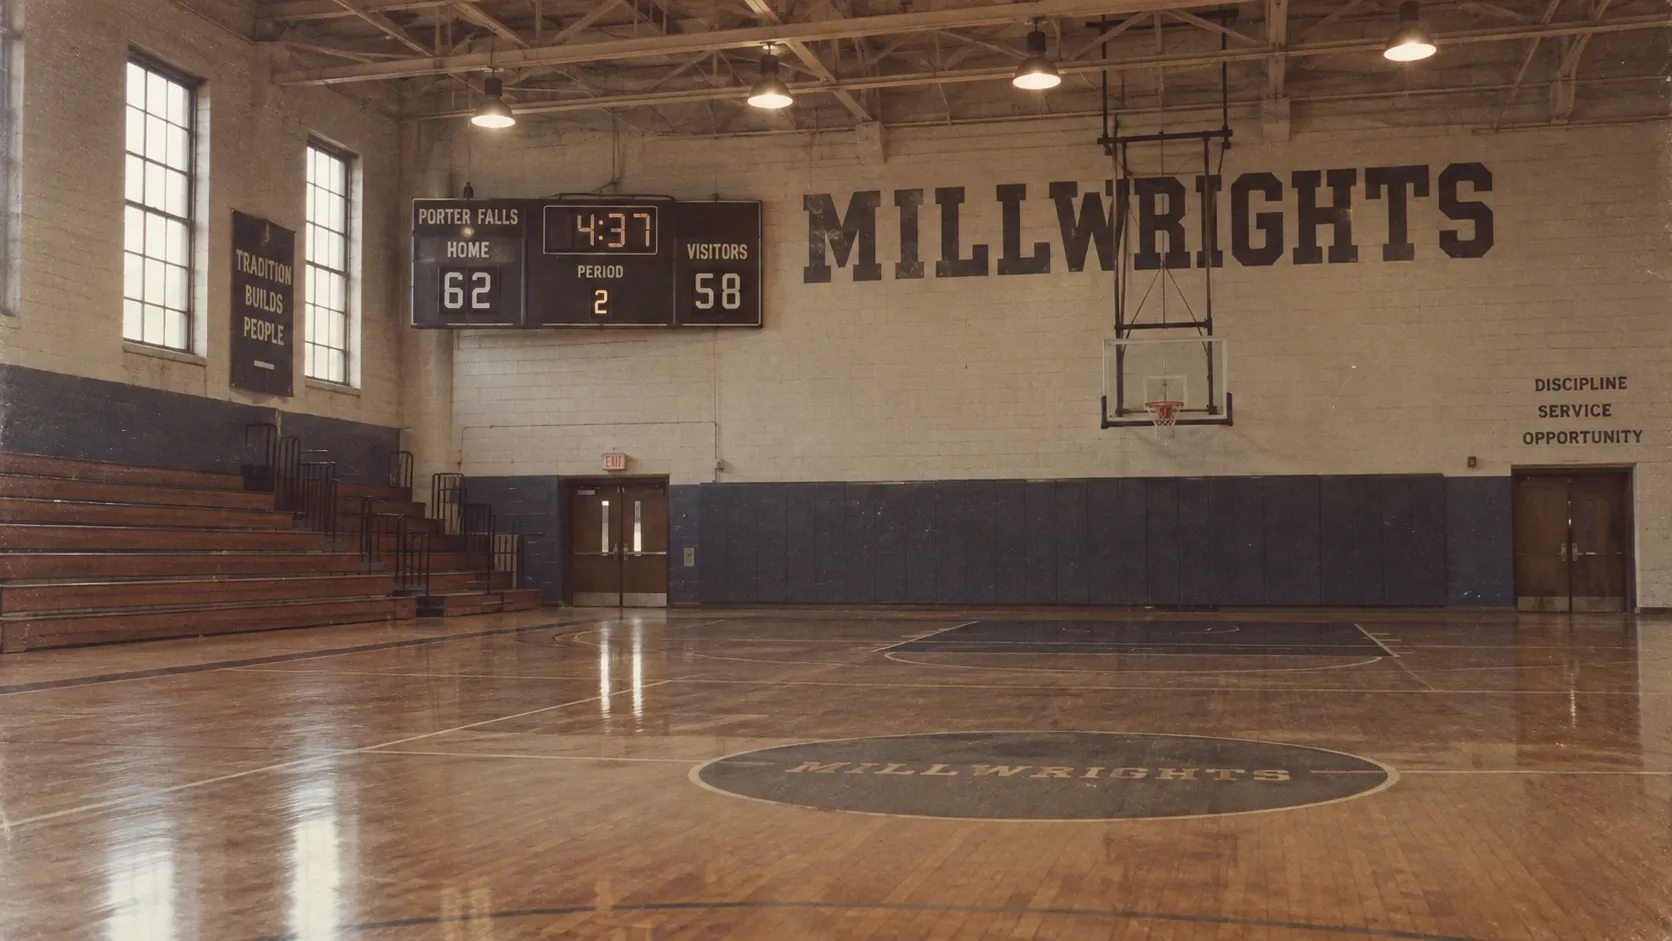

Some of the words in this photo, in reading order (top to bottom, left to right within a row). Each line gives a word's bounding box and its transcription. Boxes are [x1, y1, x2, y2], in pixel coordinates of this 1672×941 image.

[418, 208, 471, 226] PORTER
[478, 208, 519, 226] FALLS
[803, 162, 1494, 284] MILLWRIGHTS
[577, 213, 651, 248] 4:37
[447, 241, 490, 259] HOME
[687, 243, 748, 260] VISITORS
[236, 249, 291, 285] TRADITION
[577, 265, 624, 279] PERIOD
[245, 284, 283, 314] BUILDS
[443, 272, 491, 309] 62
[594, 289, 608, 314] 2
[695, 273, 741, 309] 58
[243, 316, 284, 345] PEOPLE
[1535, 376, 1628, 392] DISCIPLINE
[1538, 403, 1612, 418] SERVICE
[1522, 430, 1643, 445] OPPORTUNITY
[785, 761, 1291, 781] MILLWRIGHTS
